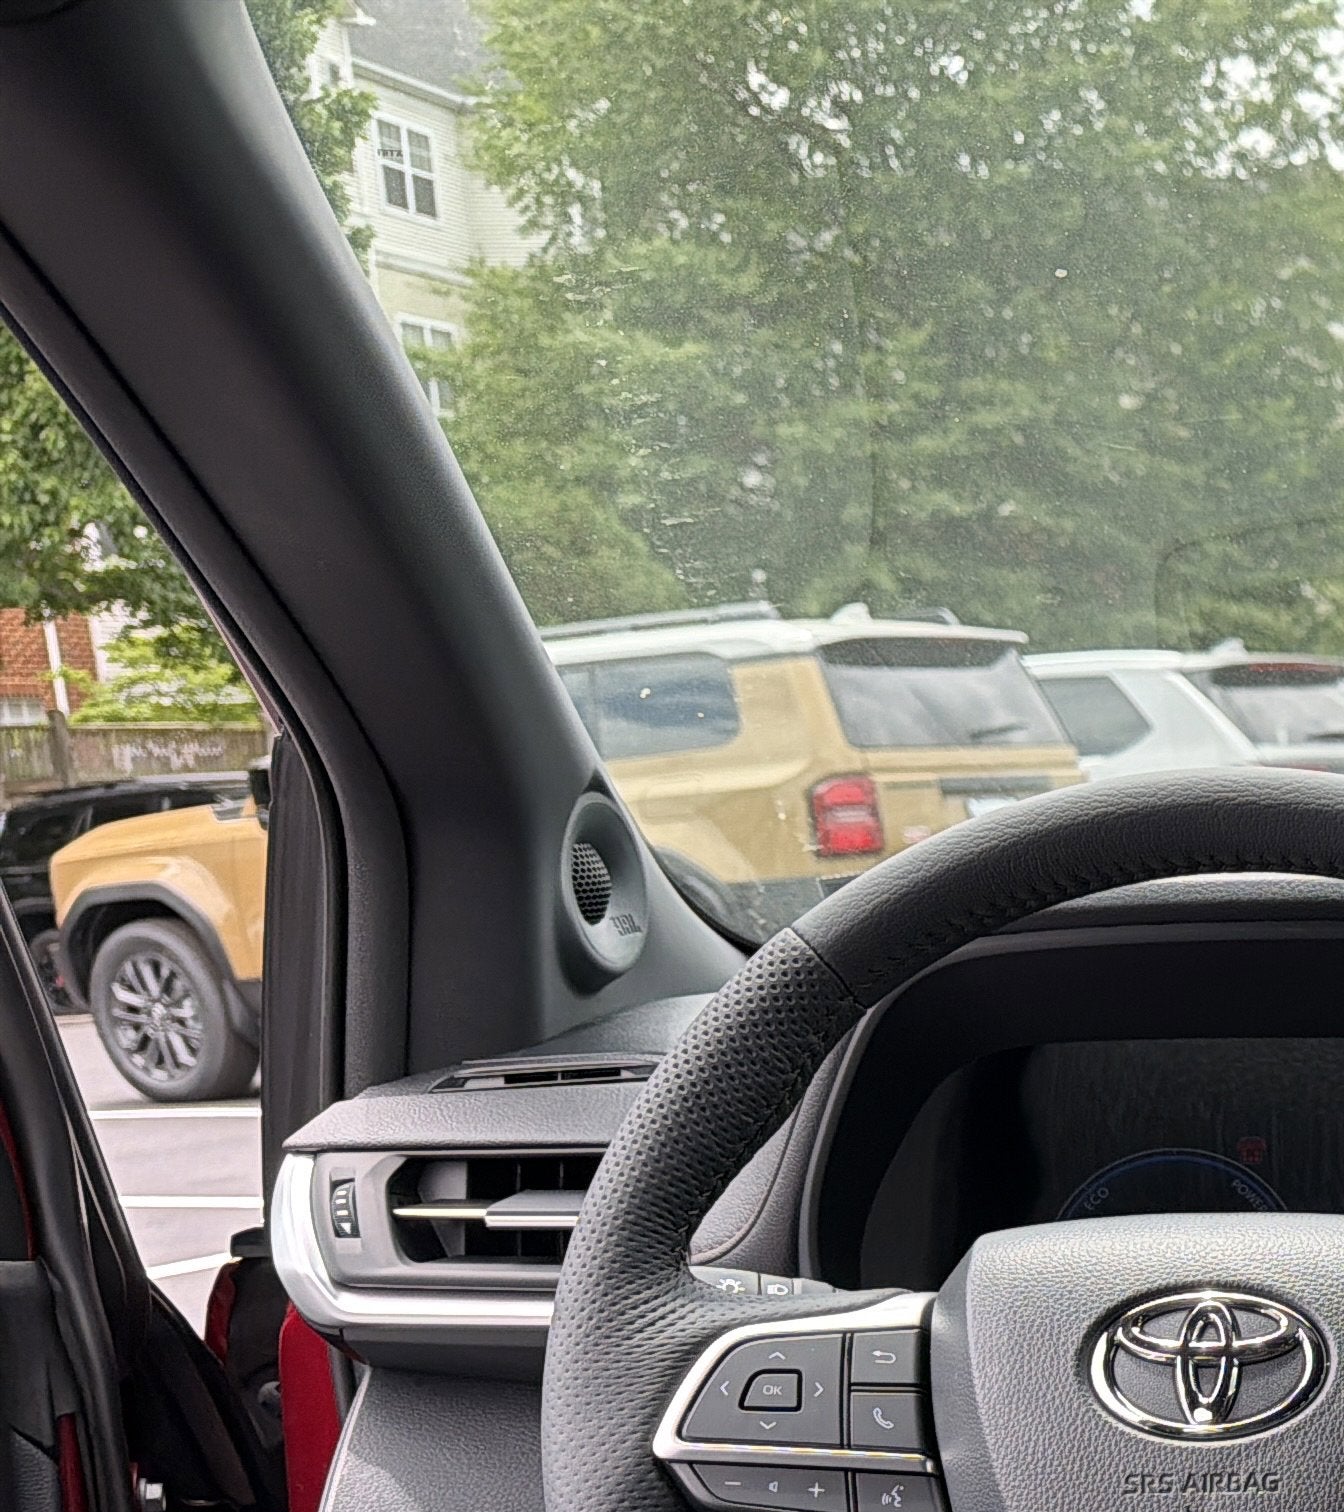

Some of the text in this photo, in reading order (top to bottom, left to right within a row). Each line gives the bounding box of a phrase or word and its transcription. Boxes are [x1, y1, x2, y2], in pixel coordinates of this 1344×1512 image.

[609, 913, 642, 936] JBL
[763, 1385, 782, 1396] OK
[1122, 1472, 1281, 1494] SRS AIRBAG
